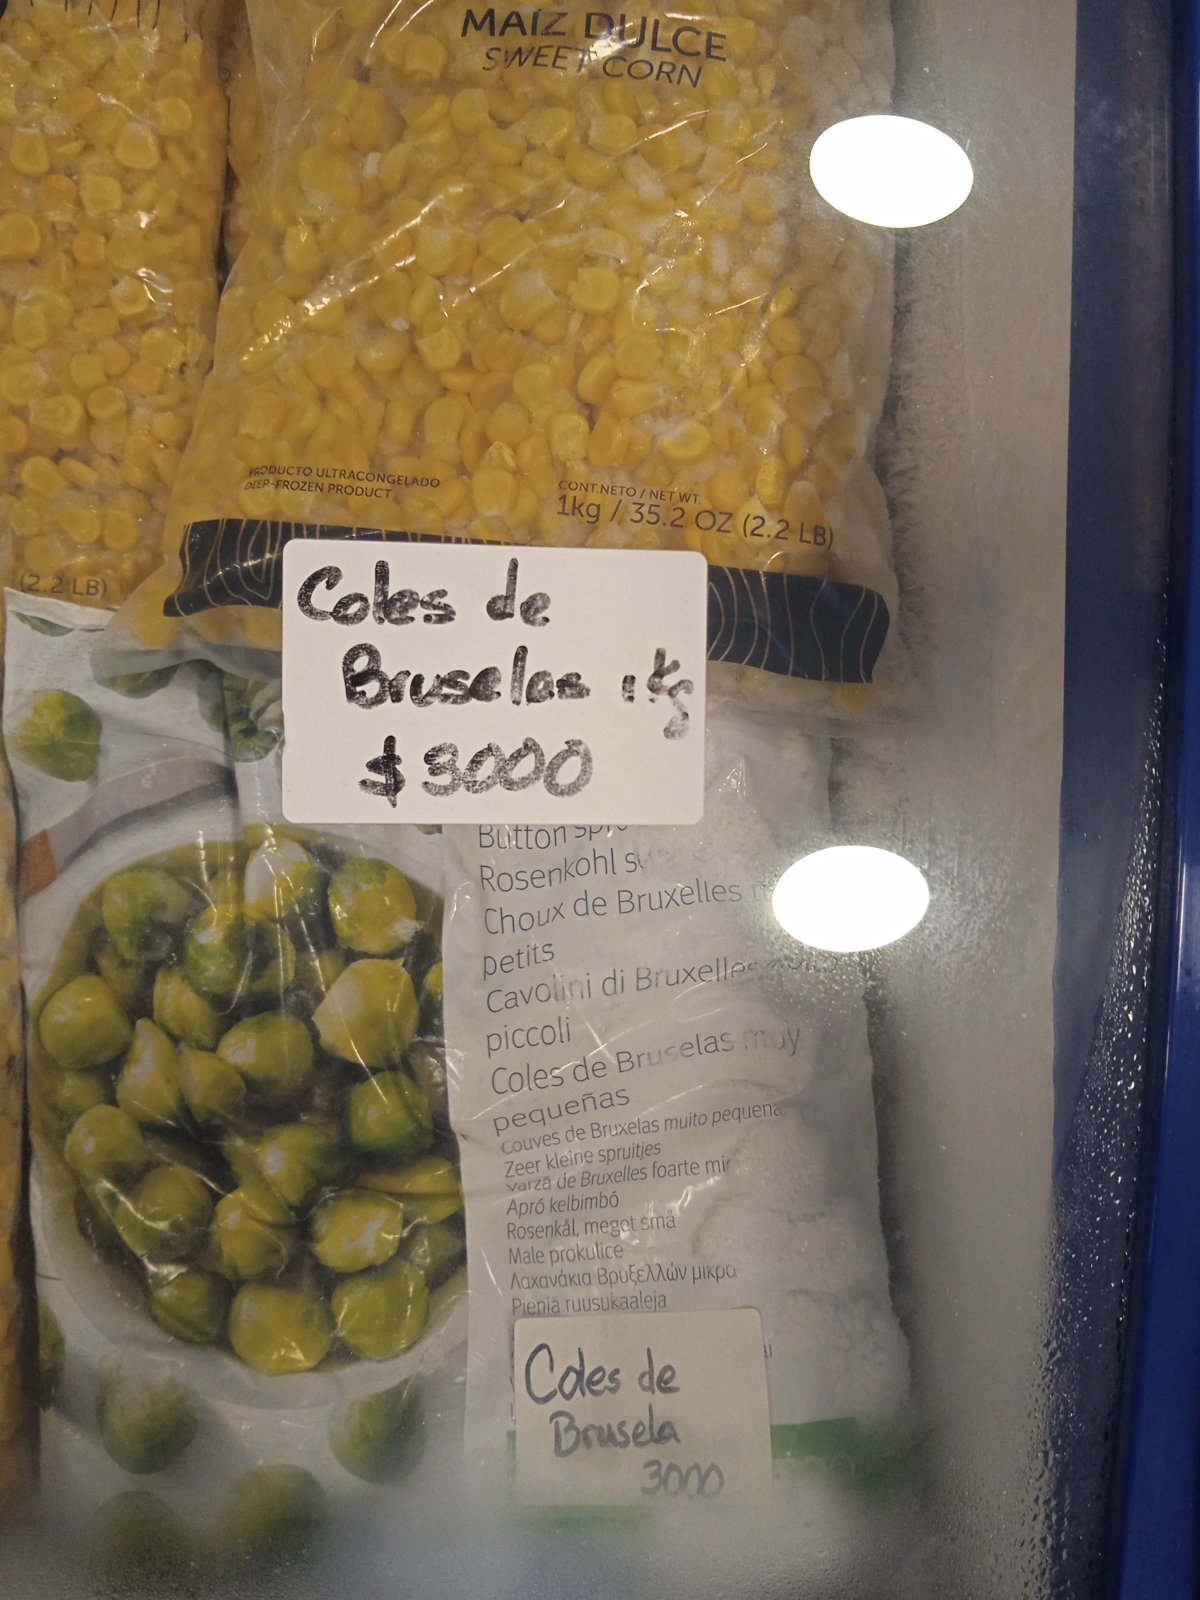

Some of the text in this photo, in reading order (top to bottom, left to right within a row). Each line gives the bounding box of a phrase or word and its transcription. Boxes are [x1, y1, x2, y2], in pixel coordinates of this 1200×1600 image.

[584, 12, 727, 62] DULCE
[482, 45, 702, 89] SWEET CORN
[244, 479, 393, 499] DEEP-FROZEN PRODUCT
[249, 465, 440, 488] PRODUCTO ULTRACONGELADO
[650, 490, 675, 501] NET
[556, 495, 602, 525] 1kg
[629, 502, 685, 528] 35.2
[694, 510, 734, 534] OZ
[742, 513, 790, 541] (2.2
[799, 523, 833, 550] LB)
[20, 574, 108, 597] (2.2 LB)
[297, 557, 552, 627] Coles de
[342, 642, 591, 710] Bruselas
[480, 848, 617, 893] Rosenkohl
[484, 902, 566, 935] Choux
[573, 890, 608, 918] de
[617, 878, 743, 915] Bruxelles
[483, 942, 555, 980] petits
[486, 970, 592, 1013] Cavolini
[602, 967, 625, 997] di
[486, 1016, 571, 1058] piccoli
[491, 1062, 564, 1095] Coles
[572, 1056, 608, 1083] de
[615, 1028, 735, 1075] Bruselas
[492, 1086, 631, 1138] pequeñas
[565, 1127, 587, 1142] de
[591, 1115, 660, 1140] Bruxelas
[664, 1112, 708, 1132] muito
[505, 1139, 662, 1178] Zeer kleine spruitjes
[556, 1171, 577, 1189] de
[580, 1161, 648, 1188] Bruxelles
[652, 1158, 700, 1180] foarte
[506, 1189, 620, 1218] Apró kelbimbó
[507, 1209, 677, 1240] Rosenkål, meget små
[508, 1240, 624, 1267] Male prokulice
[510, 1270, 593, 1290] Λαχανάκια
[597, 1261, 687, 1287] Βρυξελλών
[565, 1290, 667, 1314] ruusukaaleja
[525, 1343, 621, 1405] Coles
[638, 1347, 680, 1394] de
[549, 1403, 681, 1457] Brusela
[640, 1459, 725, 1499] 3000
